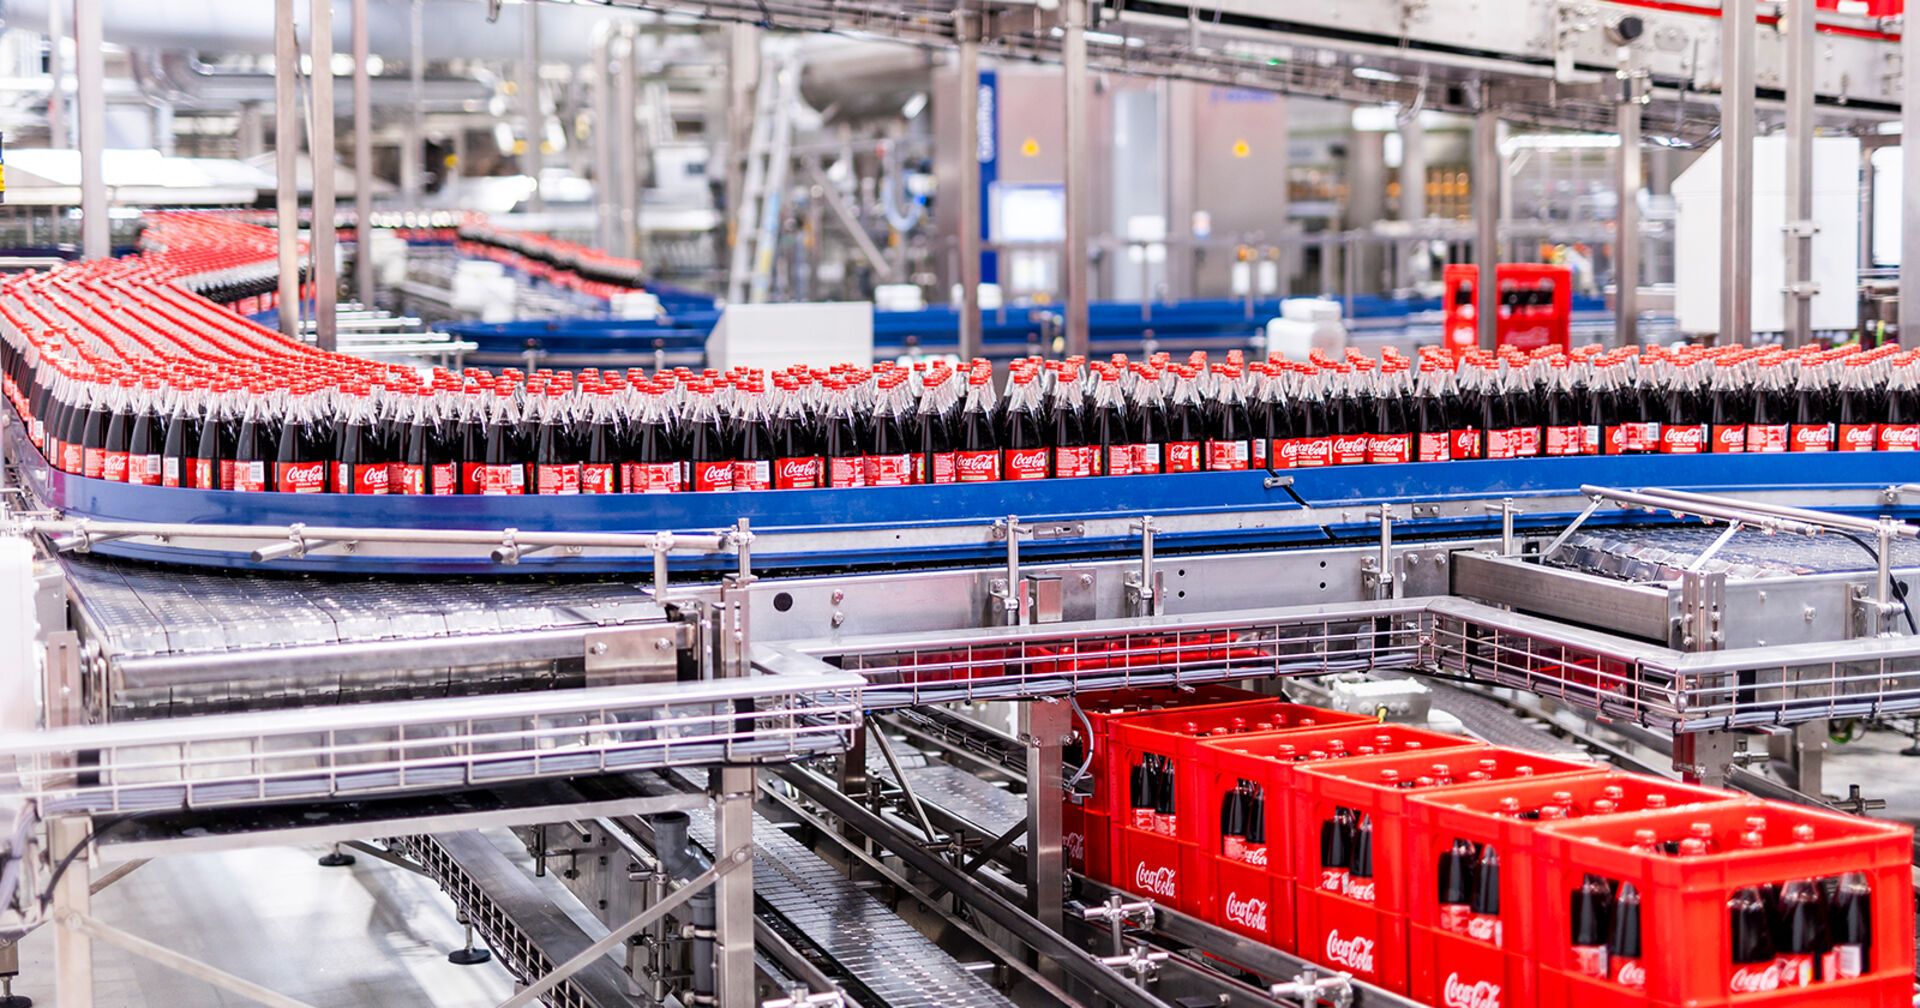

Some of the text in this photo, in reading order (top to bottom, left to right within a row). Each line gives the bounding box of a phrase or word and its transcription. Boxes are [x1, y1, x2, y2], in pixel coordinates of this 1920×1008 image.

[956, 454, 992, 470] Coca-Cola
[1136, 861, 1176, 898] Coca-Cola
[1226, 891, 1267, 932] Coca-Cola
[1326, 929, 1374, 973] Coca-Cola
